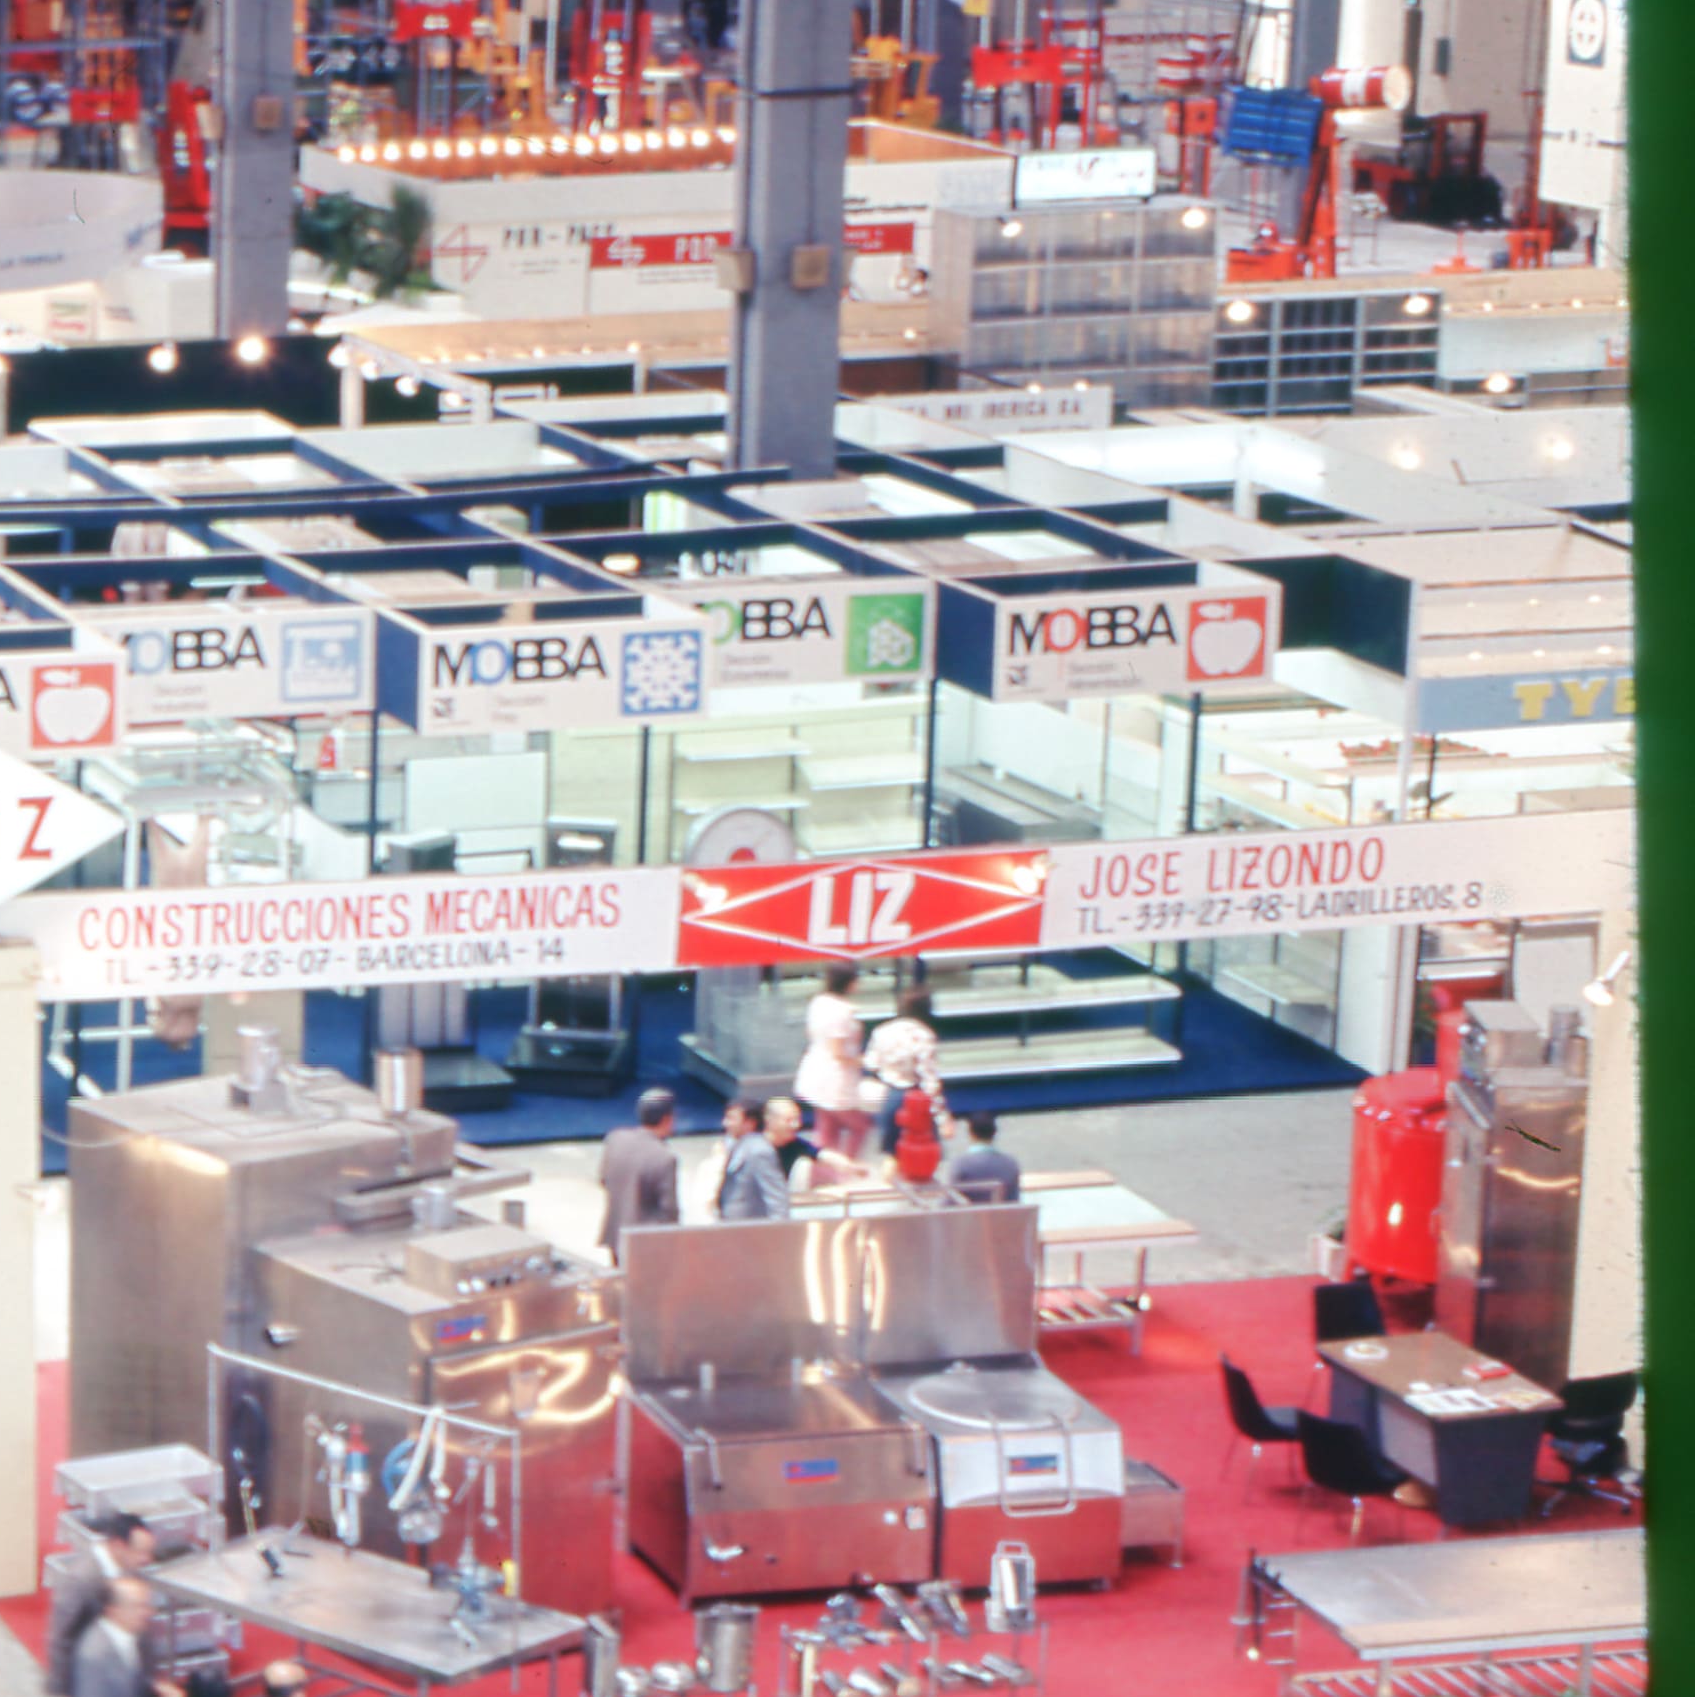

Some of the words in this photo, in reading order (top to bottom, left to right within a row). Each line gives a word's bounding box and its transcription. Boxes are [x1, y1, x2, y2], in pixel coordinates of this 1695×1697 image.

[692, 596, 832, 645] OBBA
[1010, 603, 1177, 657] MOBBA
[122, 625, 266, 676] OBBA
[434, 635, 607, 688] MOBBA
[1079, 850, 1183, 900] JOSE
[1208, 836, 1385, 893] LIZONDO
[77, 892, 410, 952] CONSTRUCCIONES
[425, 883, 622, 935] MECANICAS
[808, 870, 915, 948] LIZ
